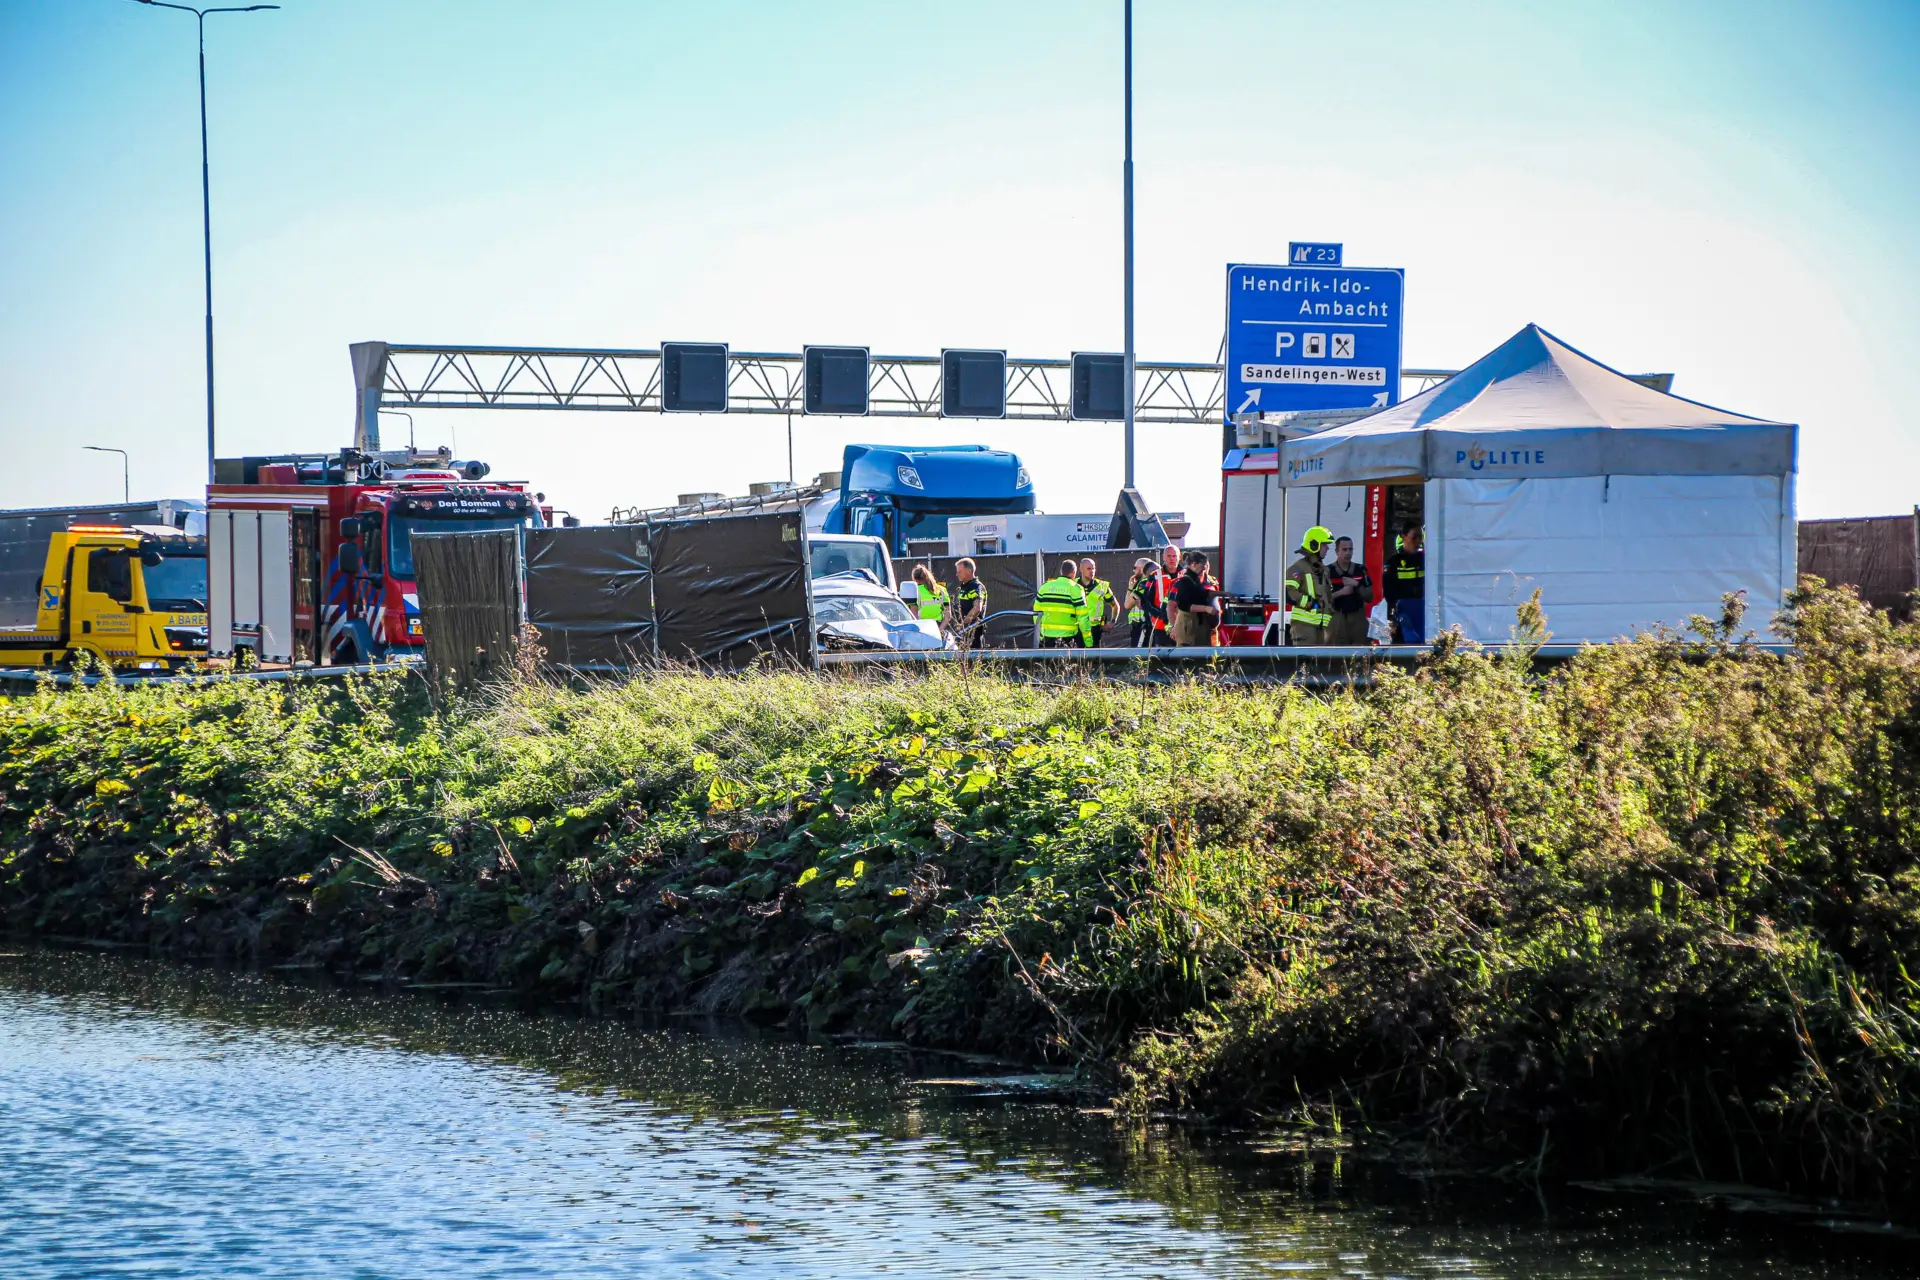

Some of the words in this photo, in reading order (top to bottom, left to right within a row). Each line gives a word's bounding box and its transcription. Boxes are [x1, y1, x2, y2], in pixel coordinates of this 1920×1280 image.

[1317, 248, 1336, 261] 23
[1242, 275, 1371, 294] Hendrik-Ido-
[1299, 299, 1388, 317] Ambacht
[1275, 331, 1295, 358] P
[1246, 366, 1381, 383] Sandelingen-West
[1288, 457, 1324, 479] POLITIE
[1456, 449, 1545, 471] POLITIE
[438, 500, 458, 508] Den
[460, 500, 501, 508] Bommel
[1066, 533, 1108, 543] CALAMITE
